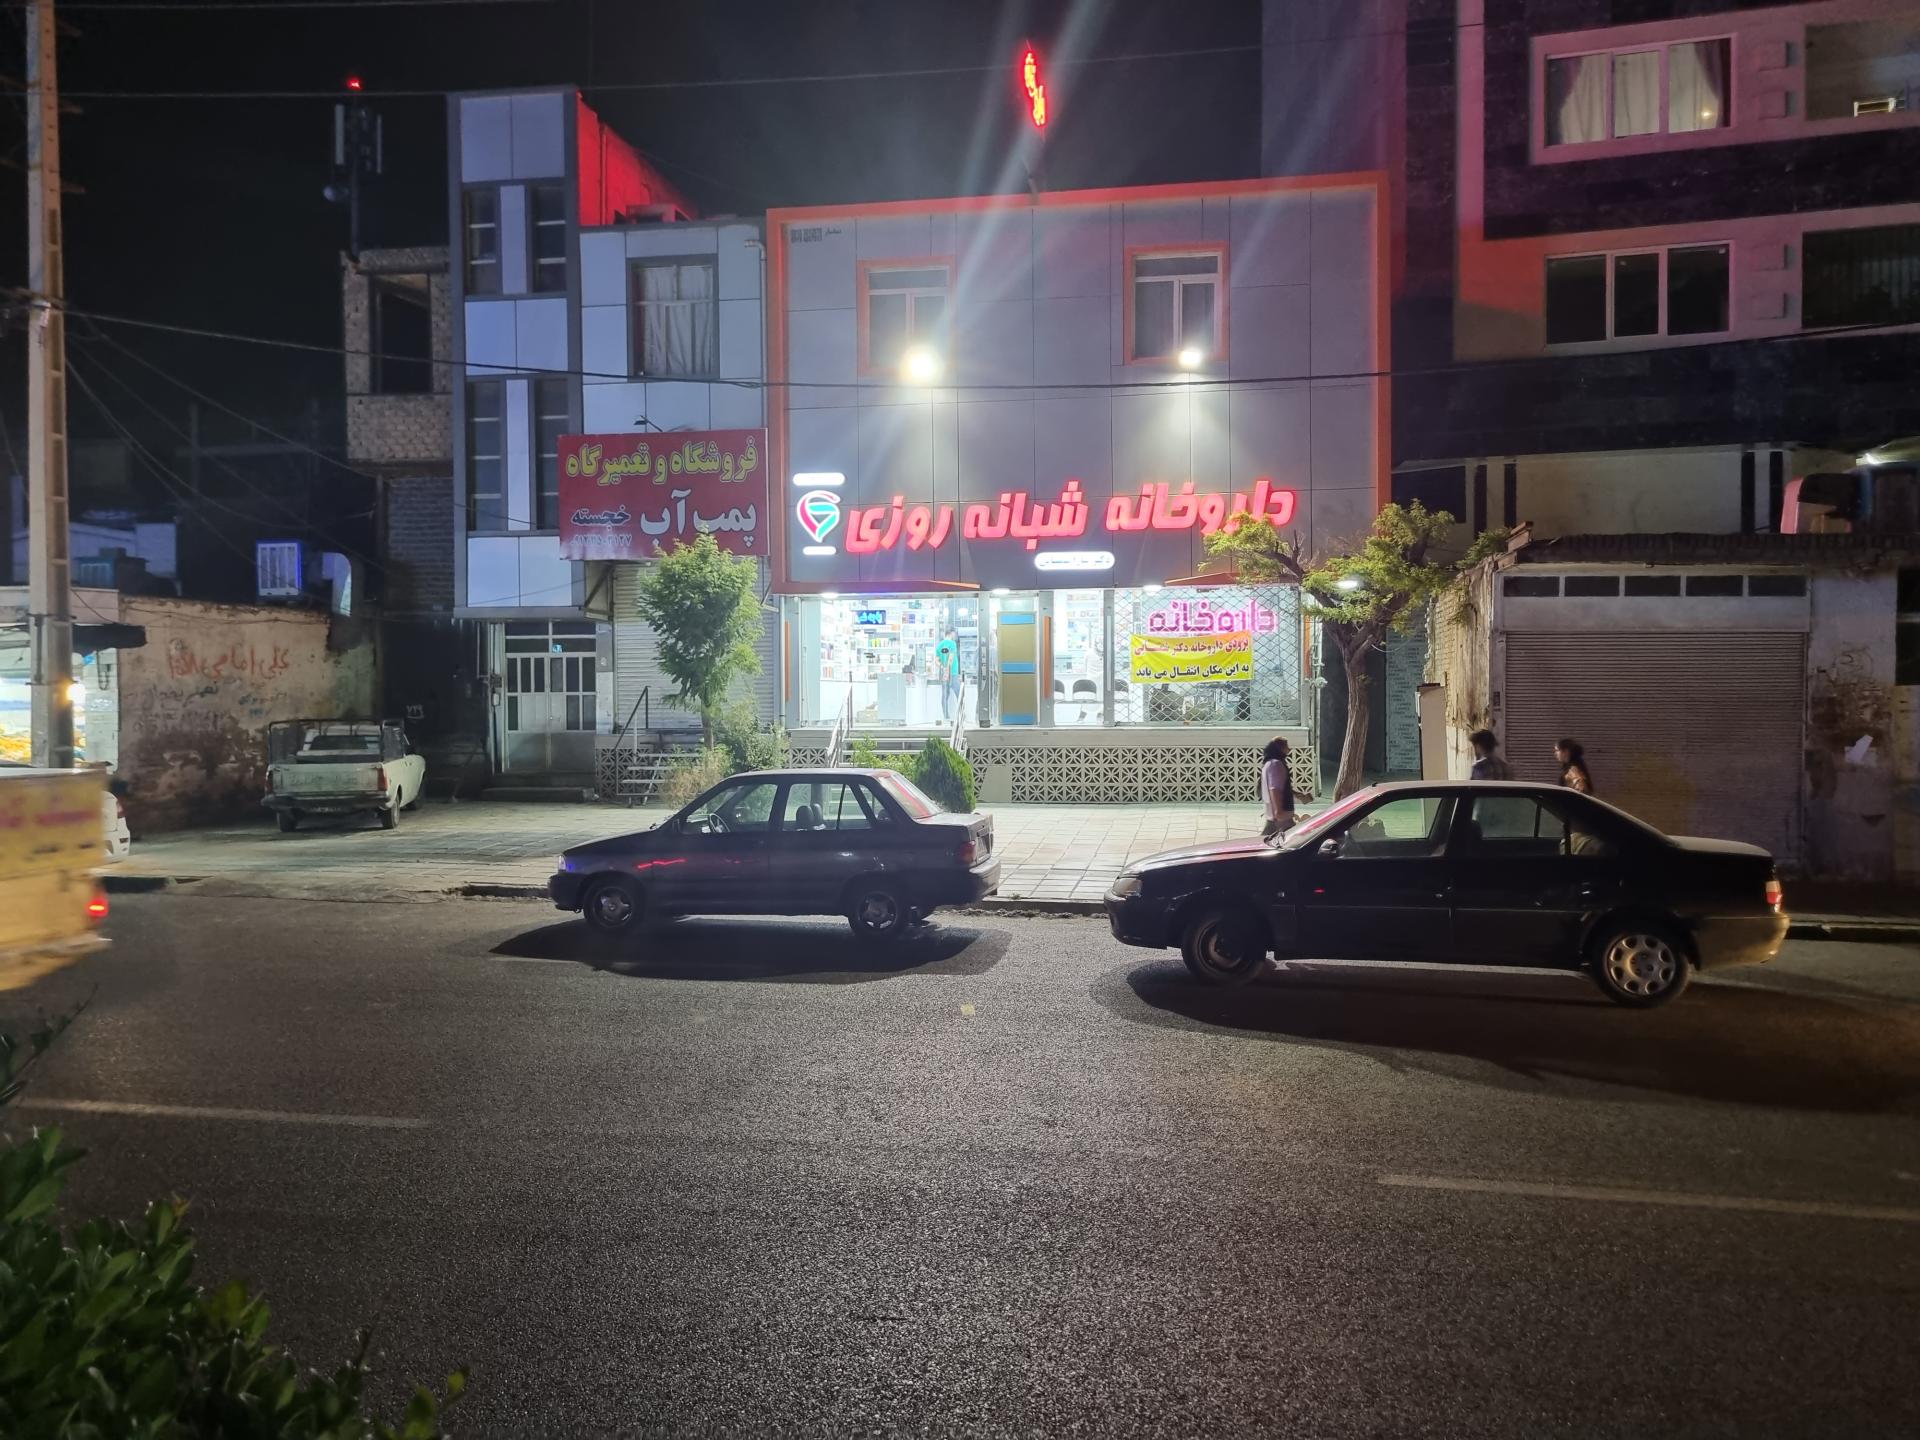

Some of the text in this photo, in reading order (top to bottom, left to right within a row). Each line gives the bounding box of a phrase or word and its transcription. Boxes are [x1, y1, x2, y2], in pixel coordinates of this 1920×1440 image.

[566, 436, 758, 486] فروشگاه و تعمیرگاه
[570, 504, 632, 532] خجسته
[640, 488, 692, 547] آب
[844, 480, 1296, 553] داروخانه شبانه روزی
[1148, 599, 1277, 634] داروخانه
[1190, 639, 1224, 656] داروخانه
[1153, 670, 1168, 680] می
[1202, 664, 1223, 678] مکان
[1225, 662, 1239, 677] این
[1240, 664, 1250, 675] به
